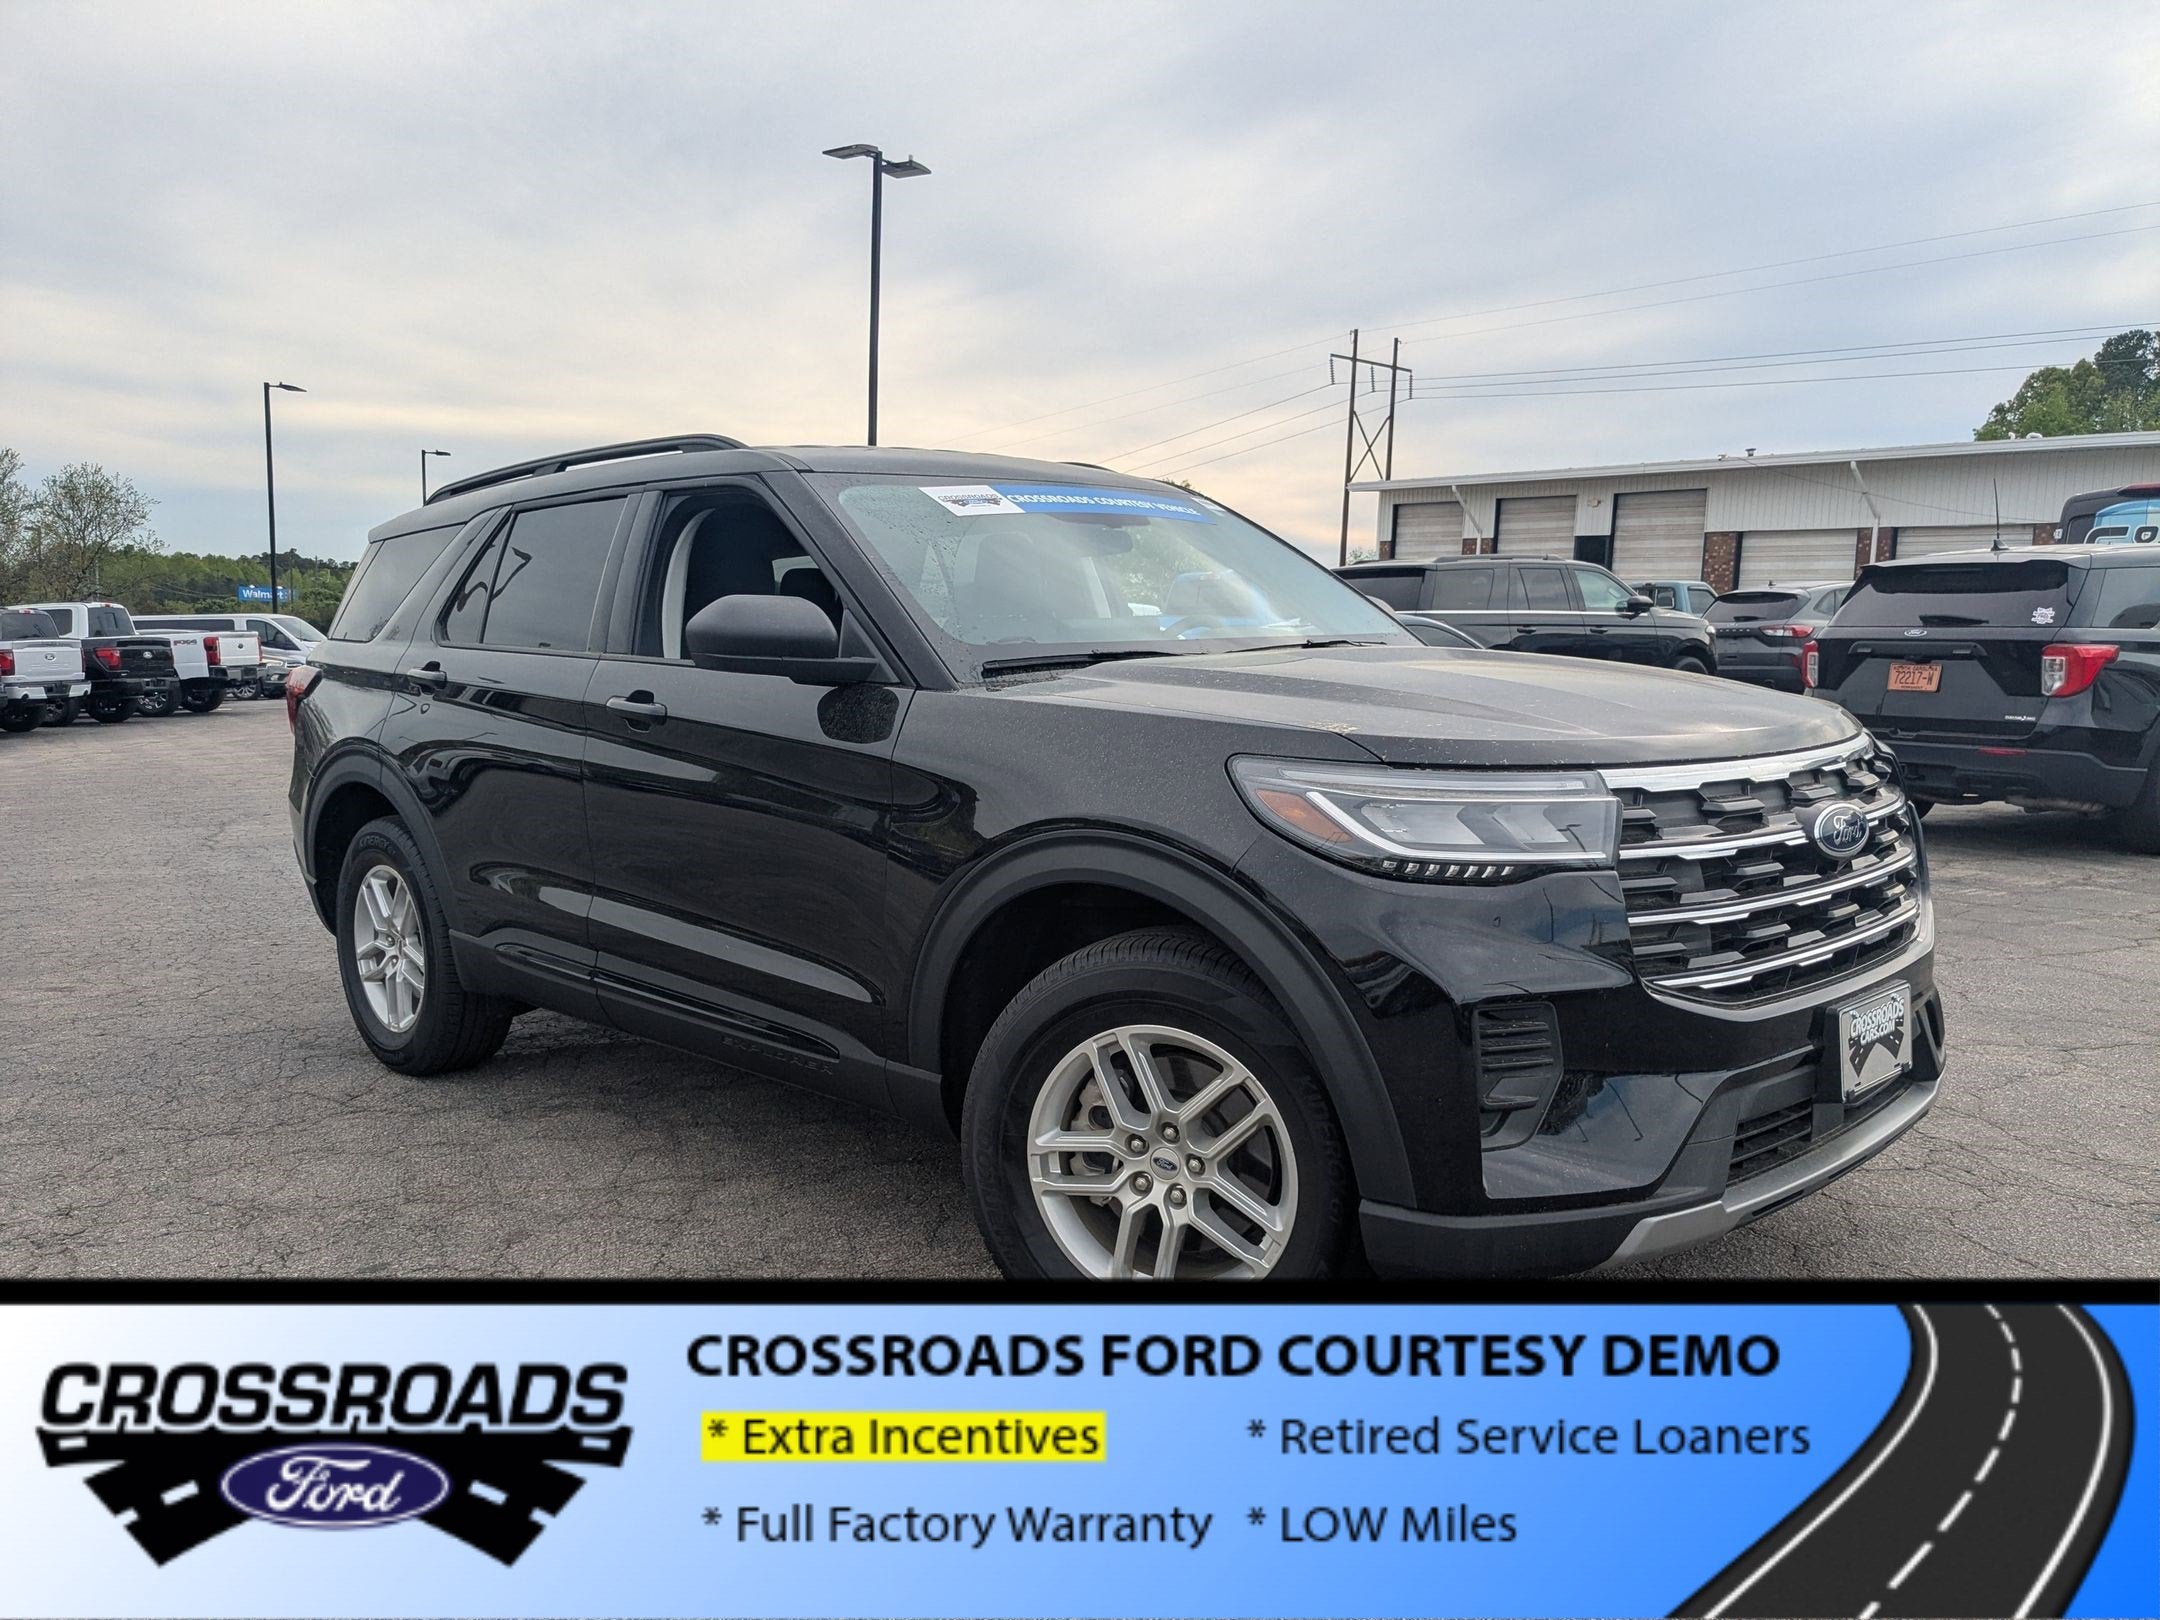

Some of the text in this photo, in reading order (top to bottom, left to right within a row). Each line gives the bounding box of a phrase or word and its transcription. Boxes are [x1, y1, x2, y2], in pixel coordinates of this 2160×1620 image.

[1007, 494, 1093, 505] CROSSROADS
[1833, 812, 1863, 846] Ford
[1850, 998, 1904, 1038] CROSSROADS
[1860, 1018, 1895, 1045] CARS.COM
